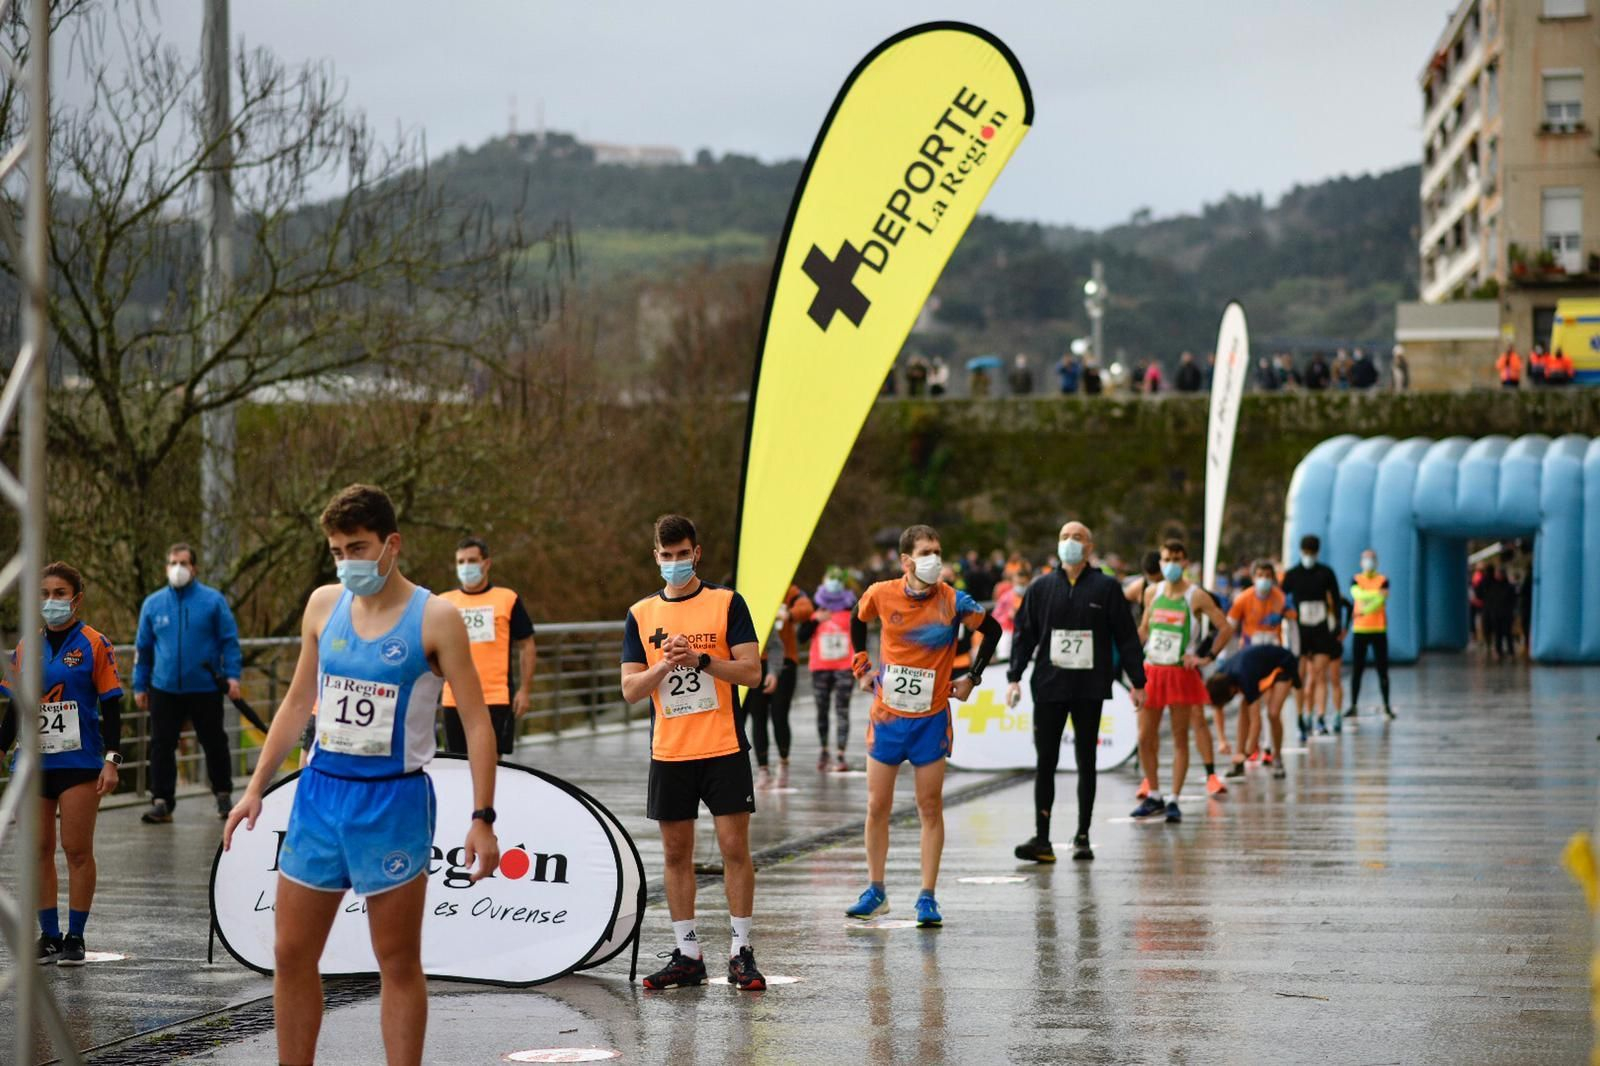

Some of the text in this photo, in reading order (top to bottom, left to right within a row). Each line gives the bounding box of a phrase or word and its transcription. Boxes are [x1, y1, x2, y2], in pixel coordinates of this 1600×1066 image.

[861, 86, 988, 274] DEPORTE
[916, 199, 949, 235] La
[464, 614, 484, 629] 28
[1061, 639, 1083, 654] 27
[1153, 637, 1172, 652] 29
[324, 675, 341, 689] La
[668, 672, 701, 697] 23
[894, 676, 922, 696] 25
[334, 695, 376, 727] 19
[38, 713, 66, 734] 24
[434, 901, 459, 917] es
